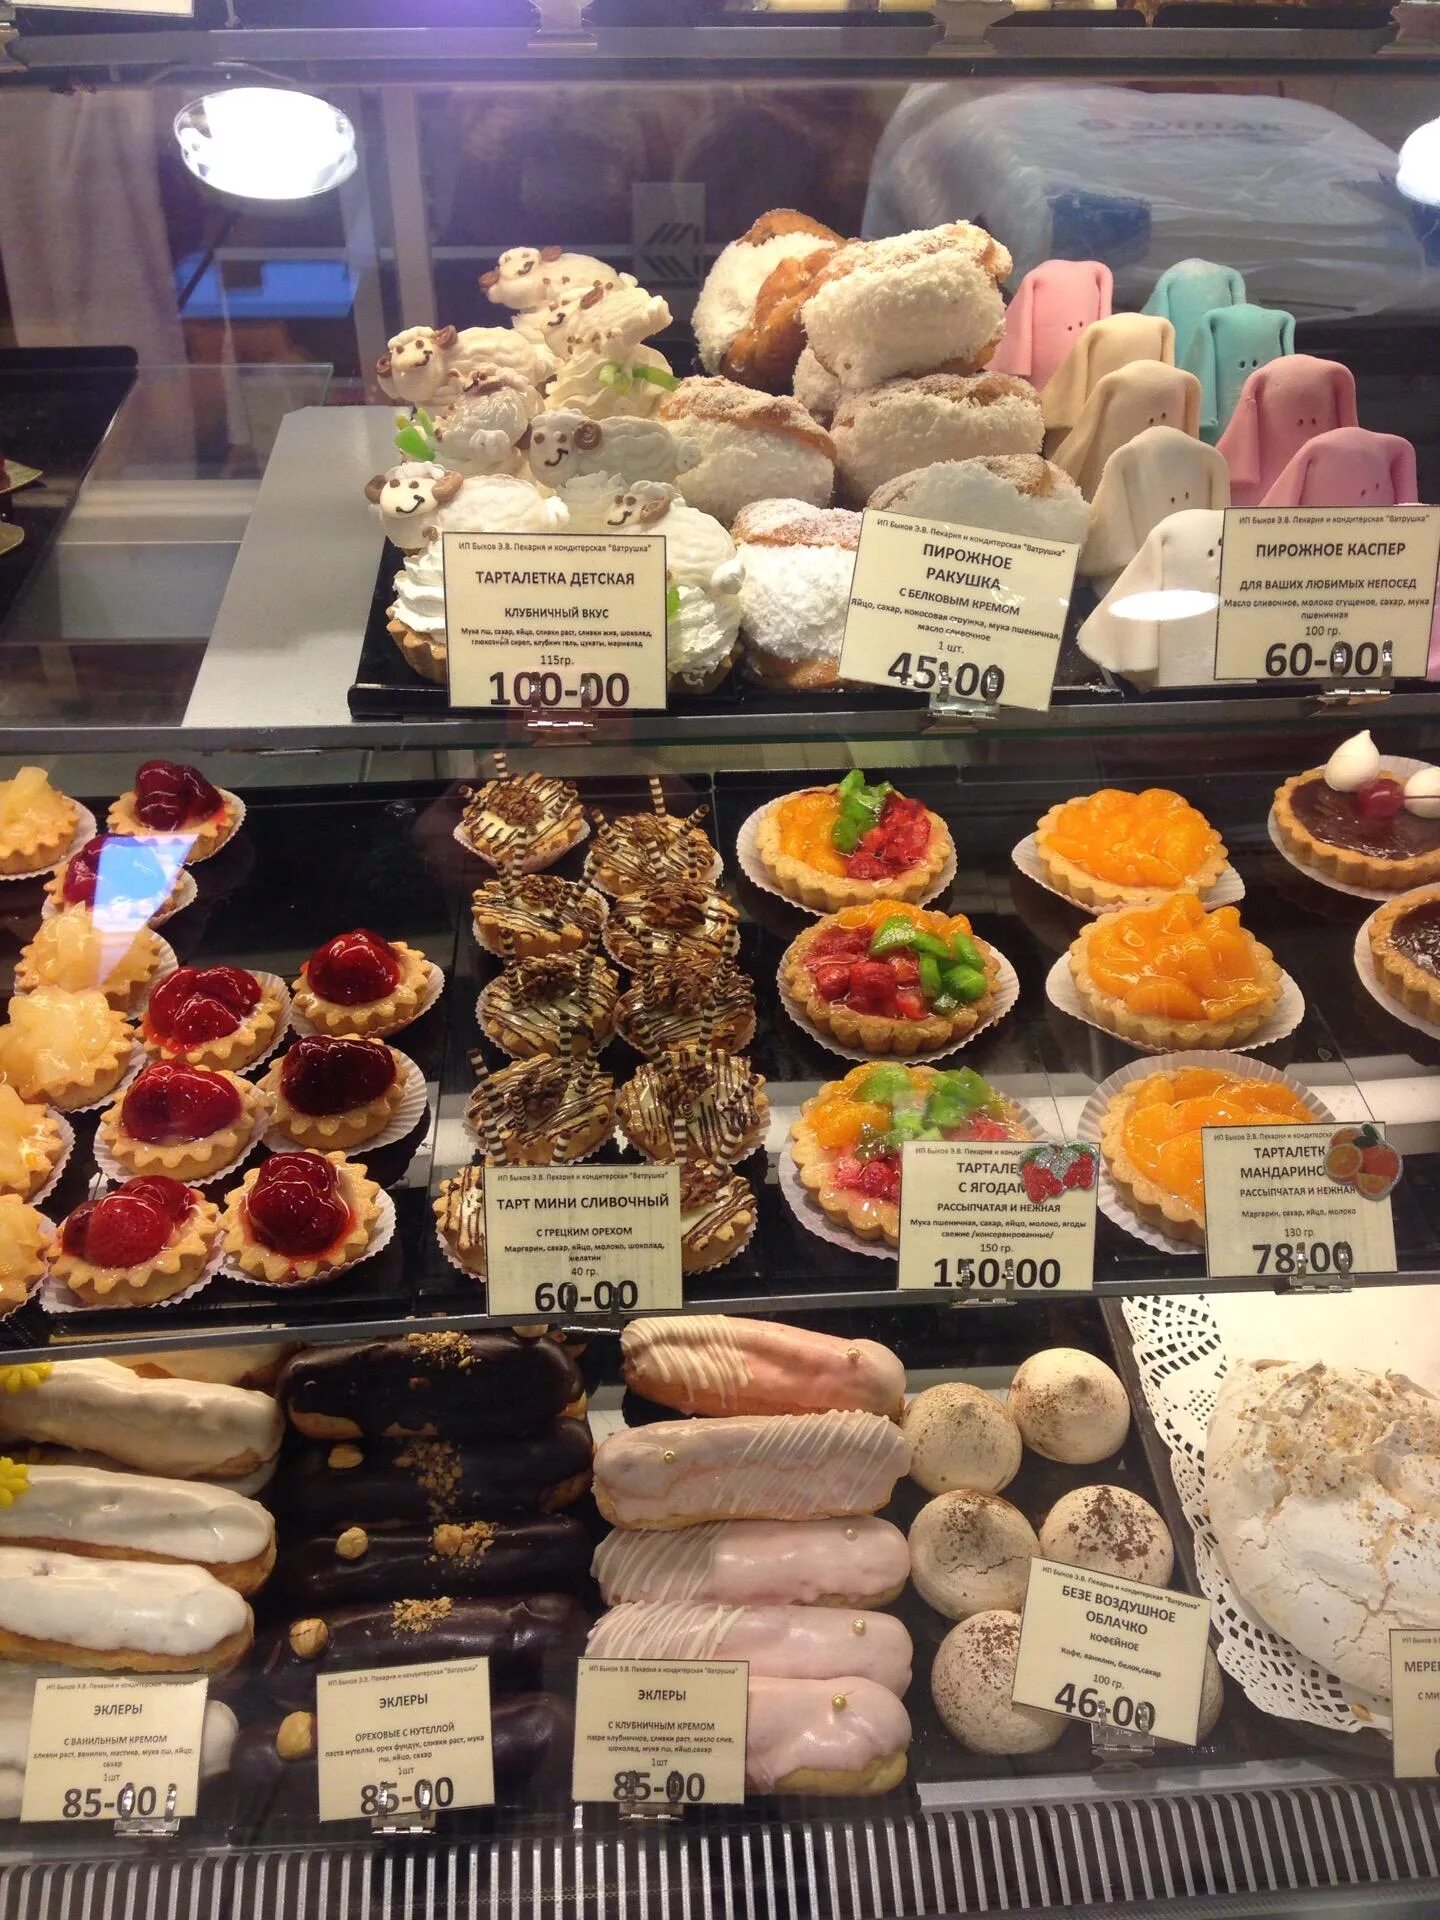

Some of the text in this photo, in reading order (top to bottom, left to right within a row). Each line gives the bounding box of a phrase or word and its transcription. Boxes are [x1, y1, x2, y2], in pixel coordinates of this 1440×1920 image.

[1292, 516, 1324, 524] Пекарня
[1332, 516, 1384, 524] кондитерская
[931, 528, 962, 540] Пекарня
[970, 535, 1022, 550] кондитерская
[514, 544, 546, 552] Пекарня
[555, 544, 606, 553] кондитерская
[1256, 543, 1406, 557] ПИРОЖНОЕ КАСПЕР
[923, 543, 1012, 570] ПИРОЖНОЕ
[476, 571, 635, 587] ТАРТАЛЕТКА ДЕТСКАЯ
[926, 567, 1001, 590] РАКУШКА
[1239, 579, 1416, 591] ДЛЯ ВАШИХ ЛЮБИМЫХ НЕПОСЕД
[899, 588, 1020, 616] С БЕЛКОВЫМ КРЕМОМ
[1224, 599, 1251, 607] Масло
[1253, 600, 1299, 608] сливочное,
[1335, 599, 1378, 607] сгущеное,
[1380, 599, 1405, 607] сахар,
[1408, 598, 1430, 607] мука
[505, 607, 609, 619] КЛУБНИЧНЫЙ ВКУС
[851, 598, 1060, 641] Яйцо, сахар, кокосовая стружка, мука пшеничная,
[917, 624, 991, 641] масло сливочное
[1305, 626, 1340, 638] 100 гр.
[938, 641, 964, 654] 1 шт.
[541, 655, 575, 667] 115гр.
[1265, 641, 1379, 676] 60-00
[888, 652, 1005, 700] 4500
[489, 671, 630, 706] 100-00
[1254, 1146, 1326, 1159] ТАРТАЛЕТК
[956, 1163, 1018, 1174] ТАРТАЛЕ
[959, 1182, 1026, 1195] С ЯГОДАМ
[1240, 1188, 1305, 1197] РАССЫПЧАТАЯ
[497, 1193, 669, 1209] ТАРТ МИНИ СЛИВОЧНЫЙ
[937, 1203, 1060, 1212] РАССЫПЧАТАЯ И НЕЖНАЯ
[1242, 1210, 1281, 1218] Маргарин,
[910, 1219, 931, 1227] Мука
[1005, 1219, 1026, 1228] яйцо,
[536, 1227, 632, 1238] С ГРЕЦКИМ ОРЕХОМ
[1284, 1228, 1301, 1237] 130
[504, 1245, 546, 1253] Маргарин,
[628, 1243, 664, 1251] шоколад,
[980, 1244, 1014, 1253] 150 гр.
[1252, 1242, 1353, 1274] 7800
[571, 1268, 598, 1277] 40 гр.
[535, 1280, 638, 1311] 60-00
[1062, 1585, 1176, 1622] БЕЗЕ ВОЗДУШНОЕ
[1086, 1611, 1148, 1635] ОБЛАЧКО
[1090, 1632, 1139, 1651] КОФЕЙНОЕ
[1061, 1647, 1082, 1659] Кофе,
[1404, 1661, 1440, 1672] МЕРЕ
[1093, 1674, 1124, 1689] 100 гр.
[379, 1694, 428, 1708] ЭКЛЕРЫ
[638, 1689, 686, 1701] ЭКЛЕРЫ
[1418, 1692, 1423, 1700] С
[93, 1704, 142, 1716] ЭКЛЕРЫ
[355, 1729, 400, 1742] ОРЕХОВЫЕ
[410, 1722, 455, 1735] НУТЕЛЛОЙ
[608, 1721, 715, 1731] С КЛУБНИЧНЫМ КРЕМОМ
[71, 1736, 127, 1745] ВАНИЛЬНЫМ
[130, 1735, 167, 1744] КРЕМОМ
[652, 1758, 668, 1766] 1шт
[398, 1767, 414, 1775] 1шт
[360, 1776, 454, 1815] 85-00
[62, 1786, 157, 1818] 85-00
